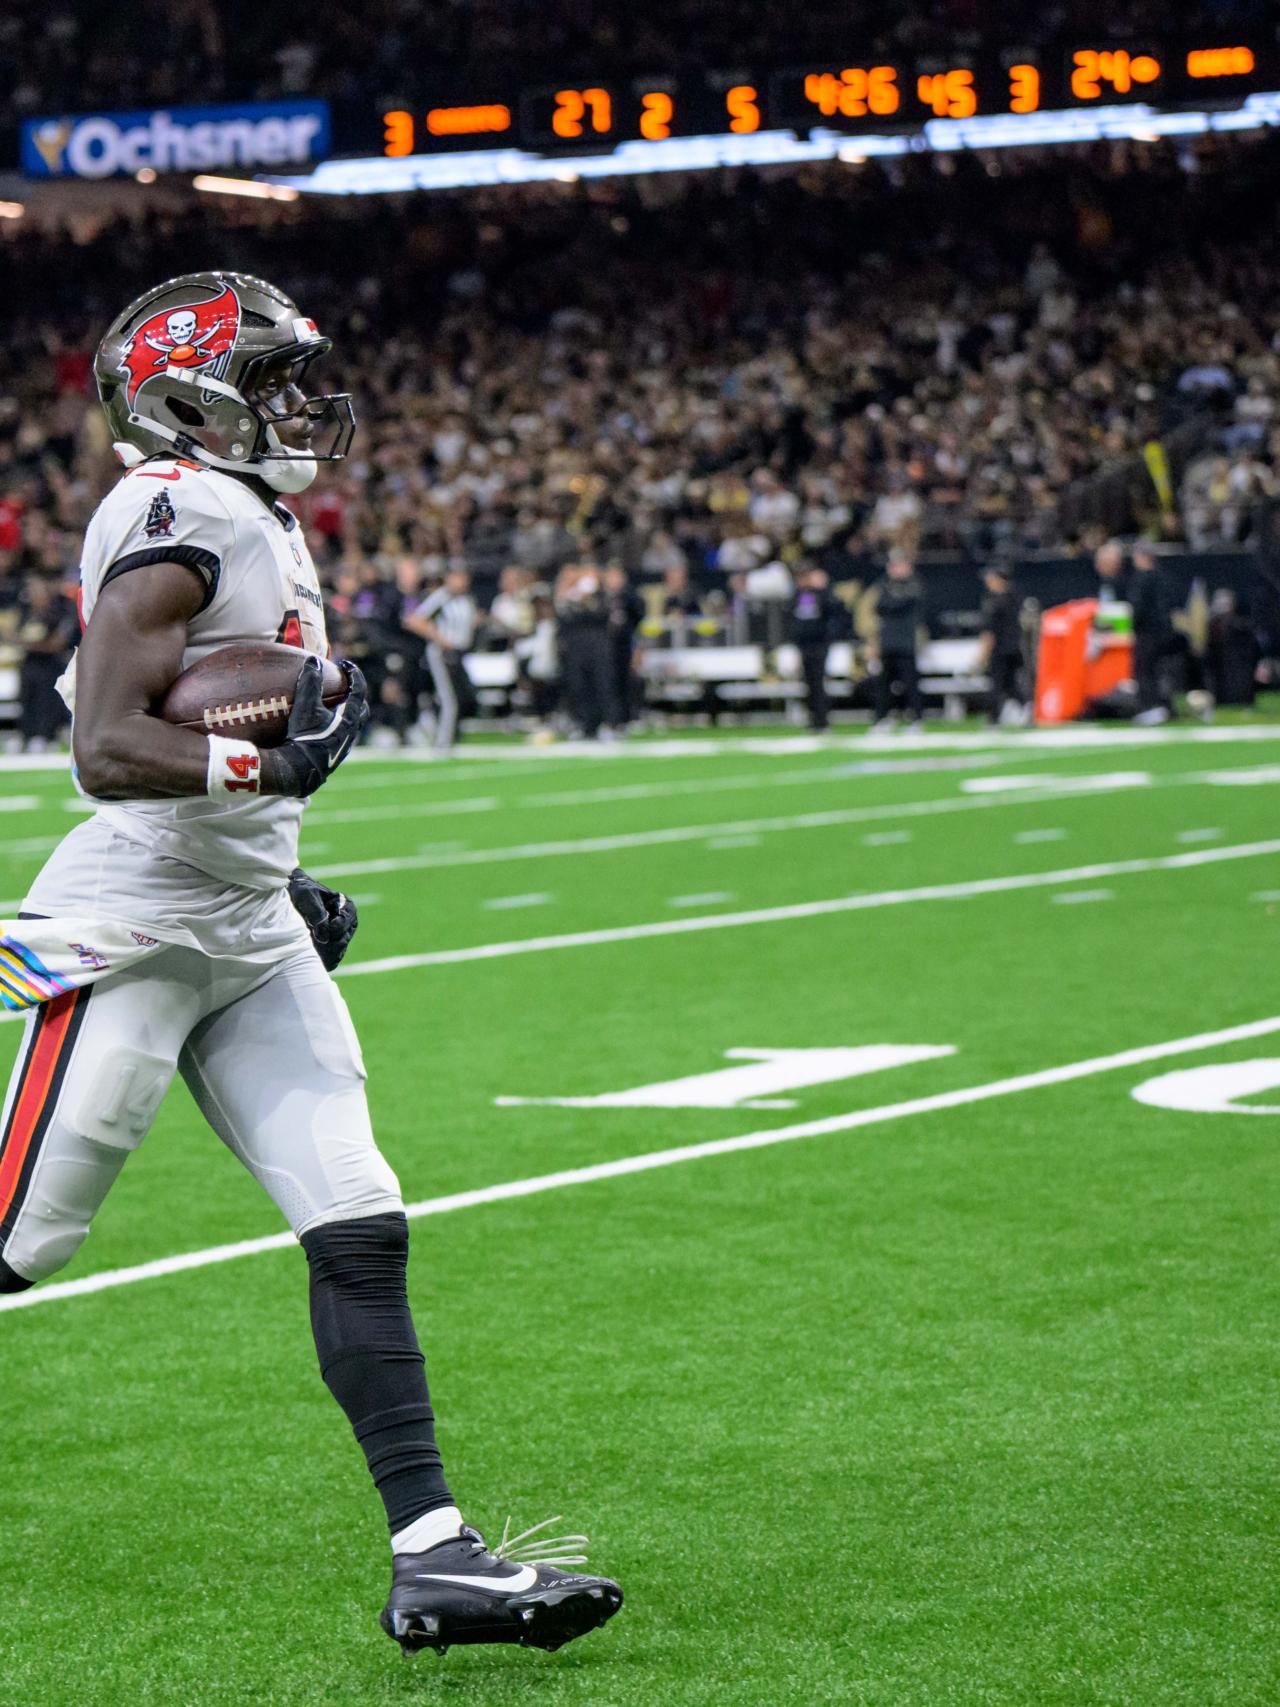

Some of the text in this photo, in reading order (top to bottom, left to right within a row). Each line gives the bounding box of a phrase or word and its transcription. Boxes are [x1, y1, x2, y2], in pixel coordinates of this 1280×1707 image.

[917, 69, 977, 119] 45
[1009, 64, 1040, 114] 3
[1071, 49, 1131, 99] 24
[383, 111, 414, 158] 3
[552, 88, 612, 138] 27
[639, 92, 673, 140] 2
[726, 85, 760, 134] 5
[67, 110, 322, 179] Ochsner
[223, 754, 259, 793] 14
[494, 1045, 958, 1108] 1
